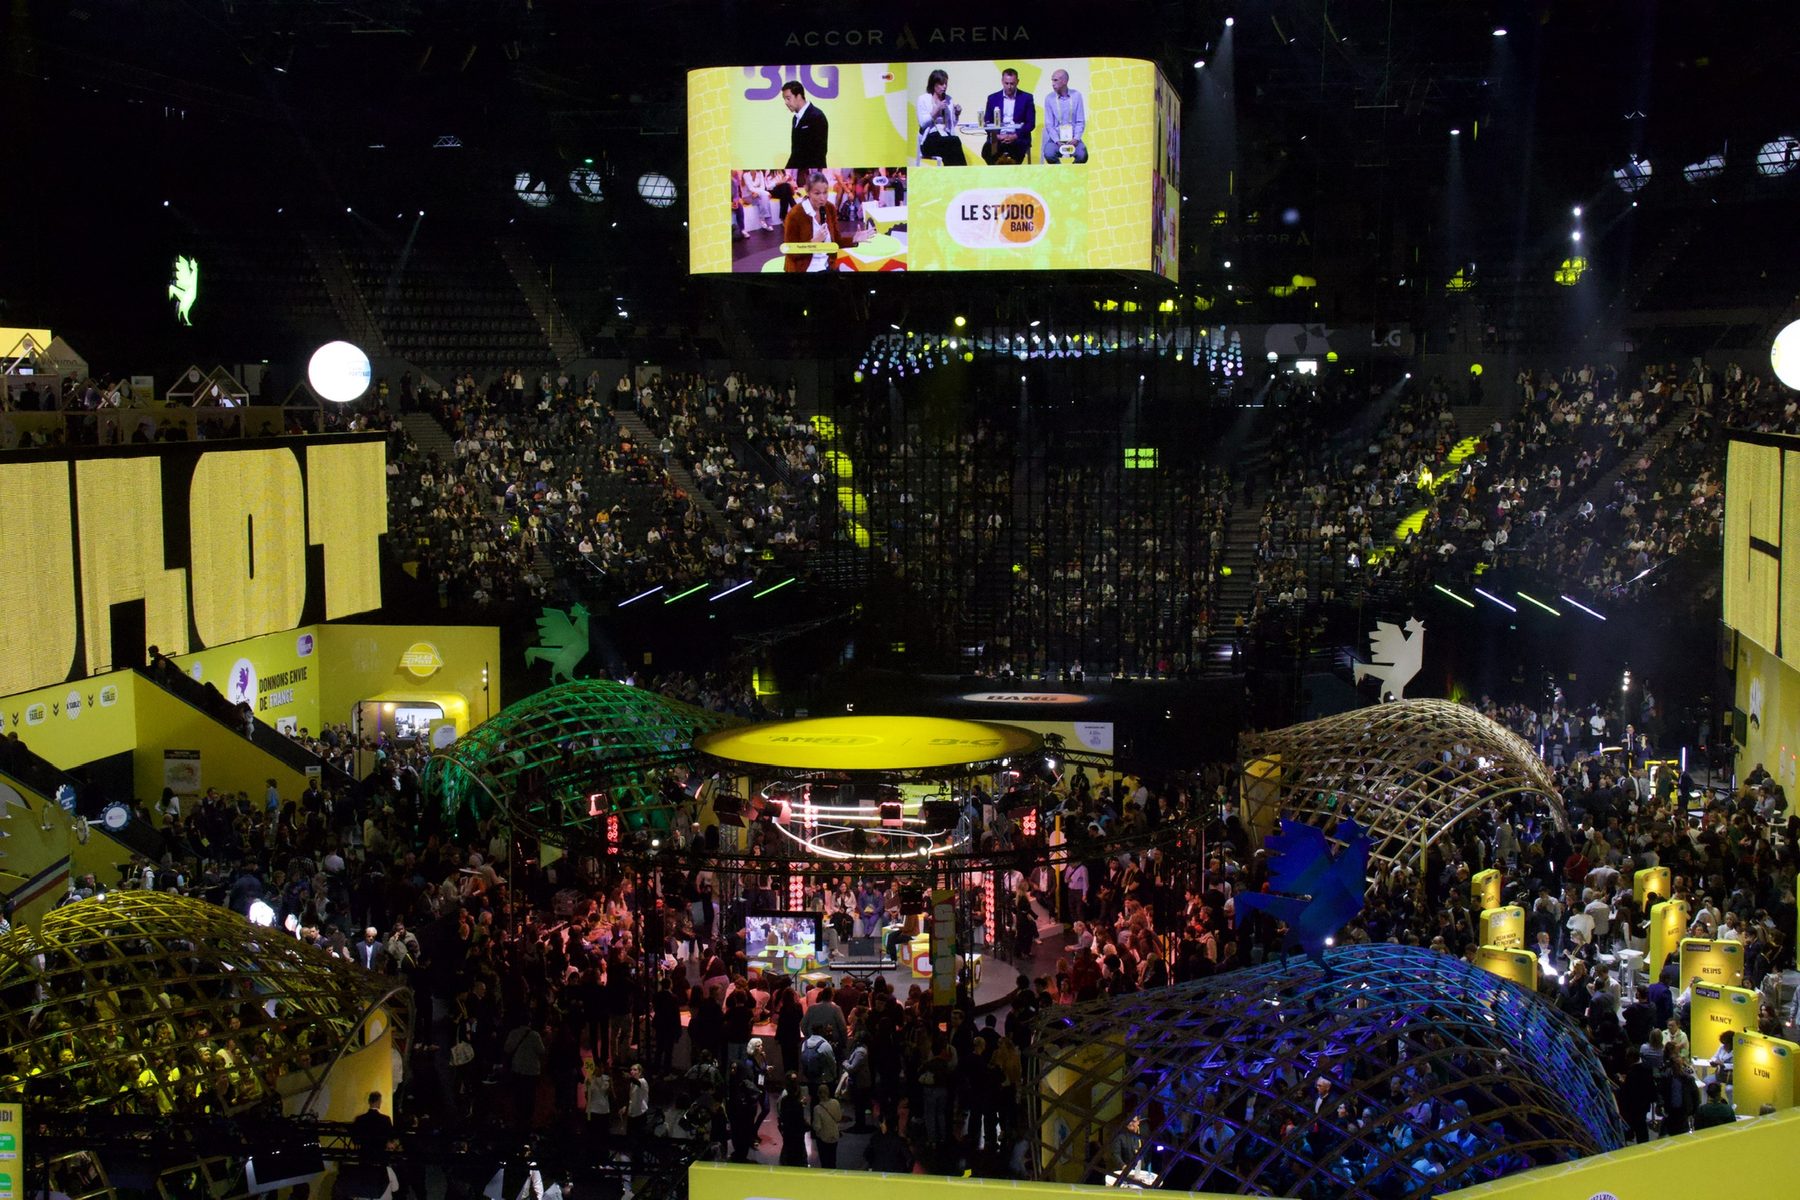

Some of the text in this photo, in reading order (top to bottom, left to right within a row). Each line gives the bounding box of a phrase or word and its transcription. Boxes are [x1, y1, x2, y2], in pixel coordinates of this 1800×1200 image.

[784, 25, 1031, 47] ACCOR ARENA
[961, 203, 1034, 221] LE STUDIO
[1010, 221, 1034, 232] BANG
[259, 666, 308, 693] DONNONS ENVIE
[259, 697, 268, 711] DE
[1702, 967, 1722, 975] REIMS
[1710, 1015, 1732, 1025] NANCY
[1753, 1067, 1770, 1079] LYON
